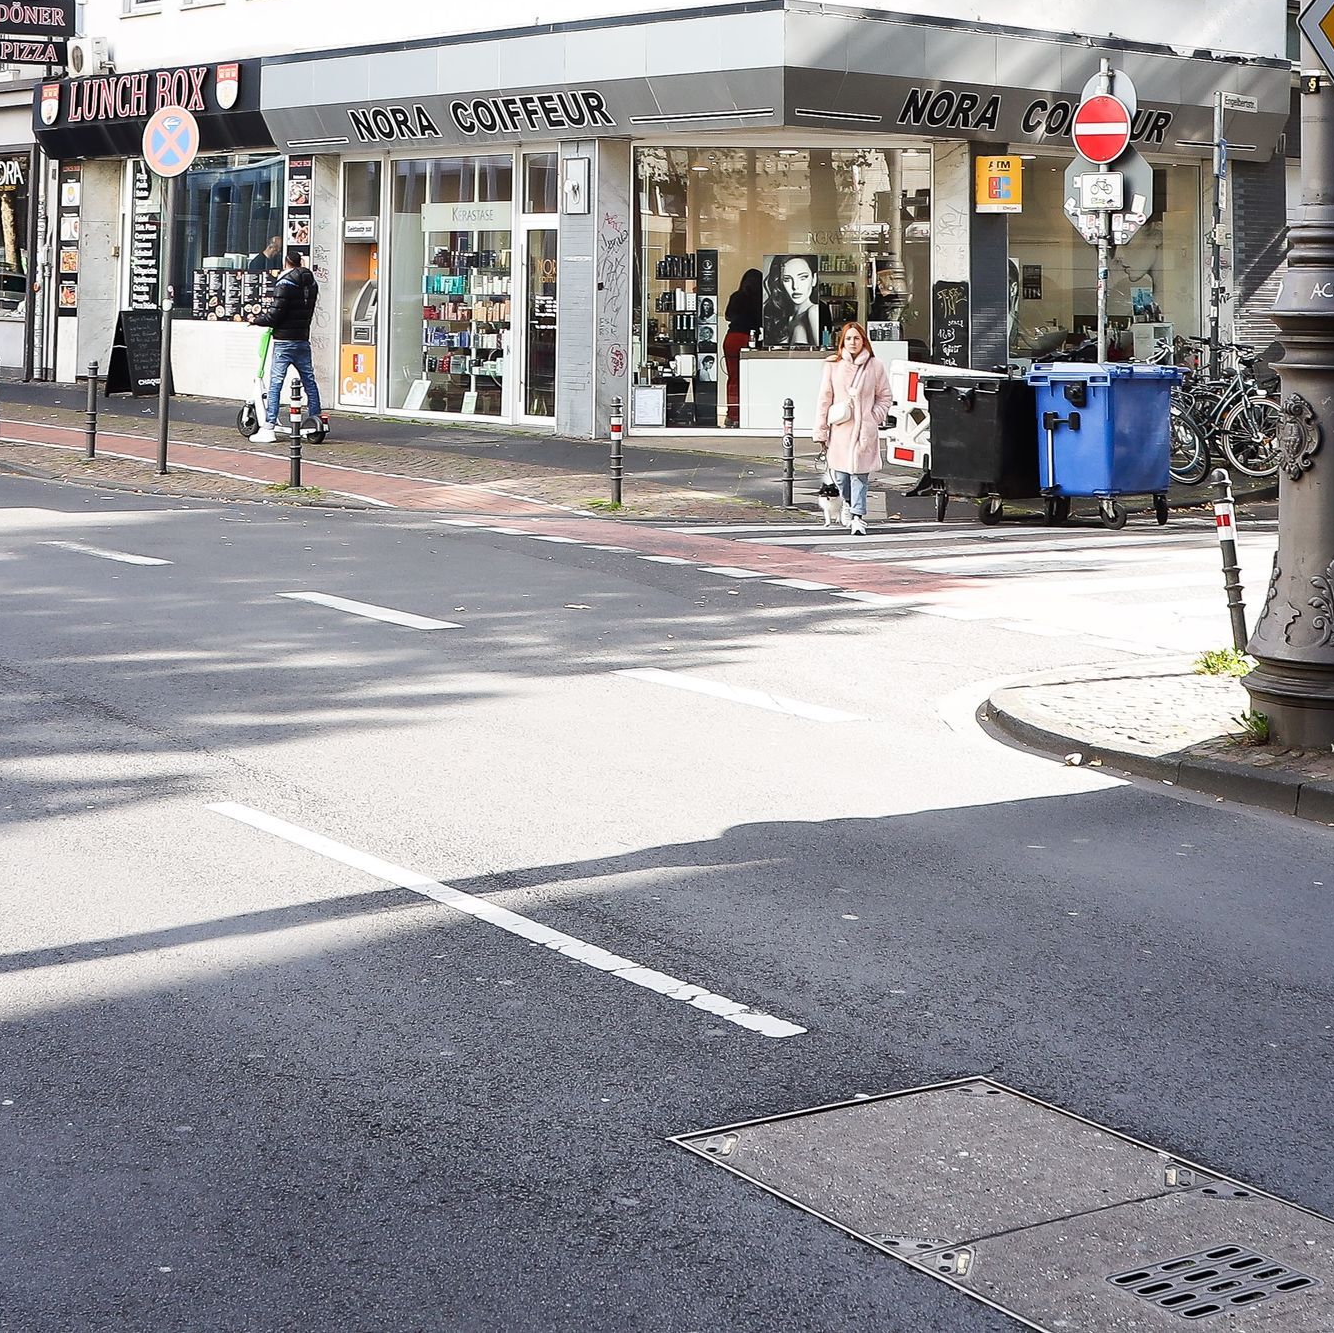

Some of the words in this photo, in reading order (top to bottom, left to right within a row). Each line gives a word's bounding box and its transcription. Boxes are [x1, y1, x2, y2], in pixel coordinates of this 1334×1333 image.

[0, 41, 58, 62] PIZZA
[68, 73, 148, 122] LUNCH
[155, 67, 207, 113] BOX
[347, 104, 443, 143] NORA
[449, 90, 618, 136] COIFFEUR
[896, 88, 1001, 131] NORA
[1021, 99, 1174, 144] COIUR
[343, 377, 376, 397] Cash
